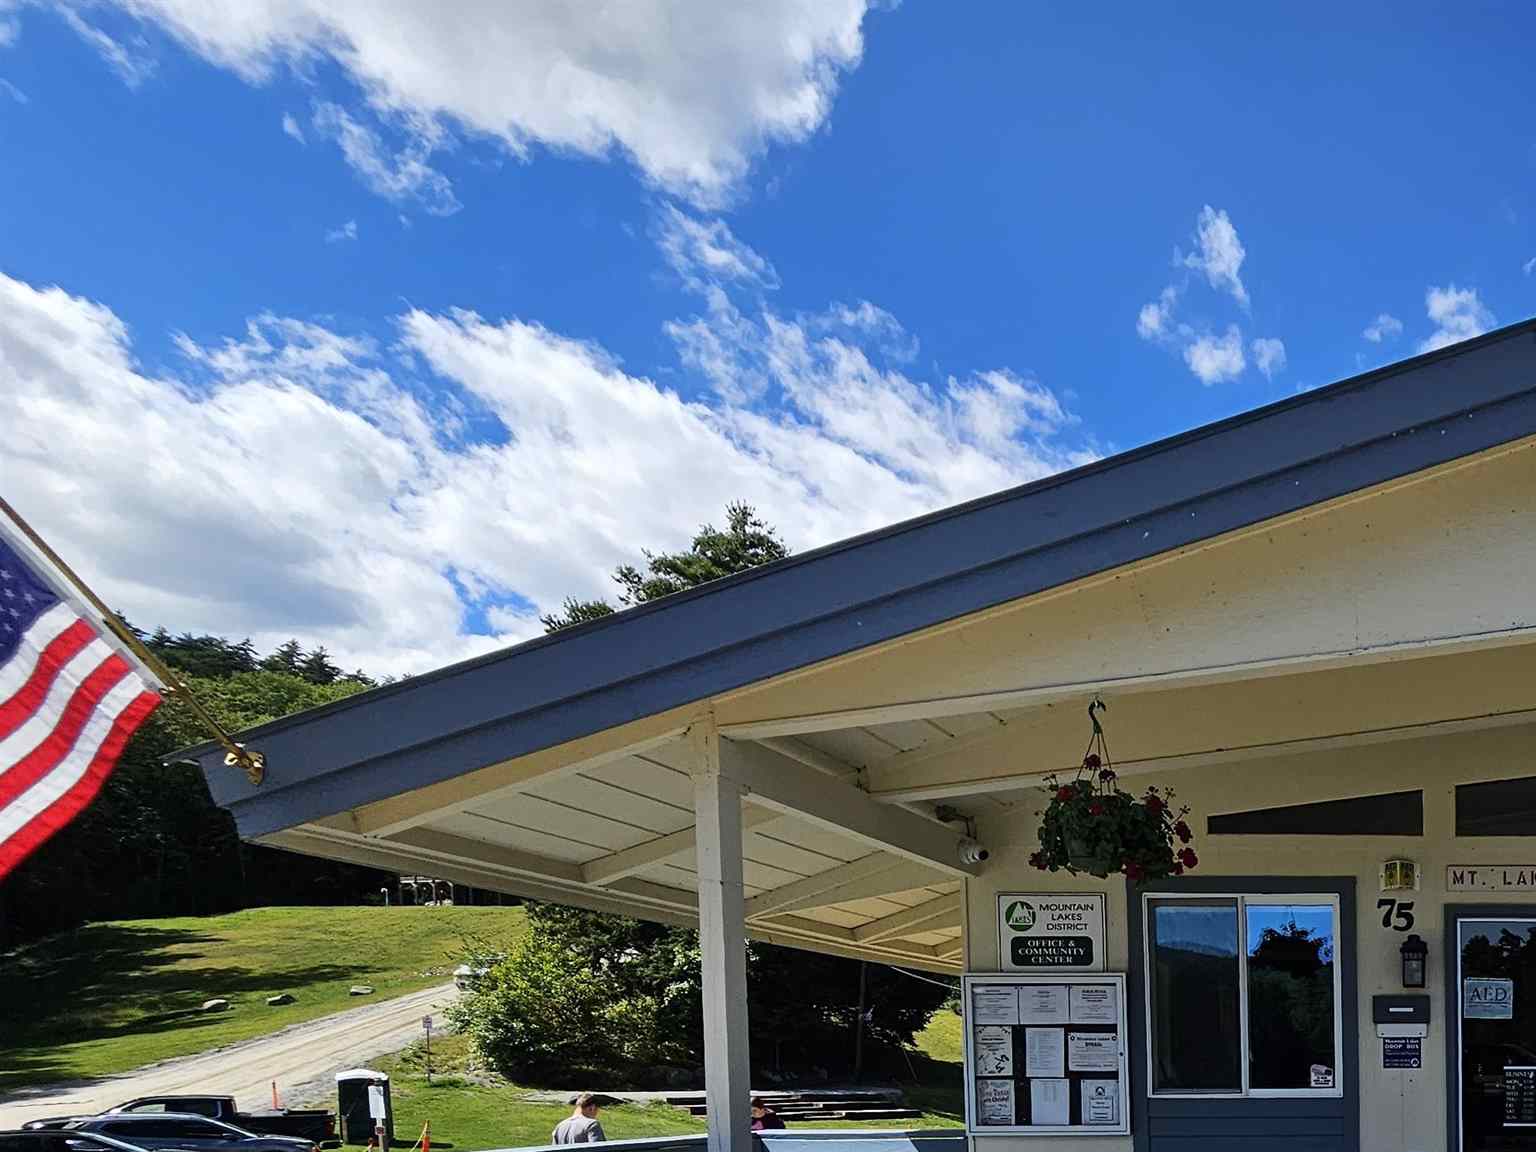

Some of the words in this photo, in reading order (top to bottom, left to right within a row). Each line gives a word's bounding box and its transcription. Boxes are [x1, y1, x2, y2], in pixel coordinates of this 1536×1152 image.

[1452, 870, 1486, 886] MT.
[1039, 903, 1094, 911] MOUNTAIN
[1051, 913, 1083, 921] LAKES
[1377, 899, 1414, 931] 75
[1046, 923, 1088, 931] DISTRICT
[1027, 939, 1064, 947] OFFICE
[1018, 947, 1085, 956] COMMUNITY
[1031, 956, 1074, 964] CENTER
[1470, 986, 1508, 1002] AED
